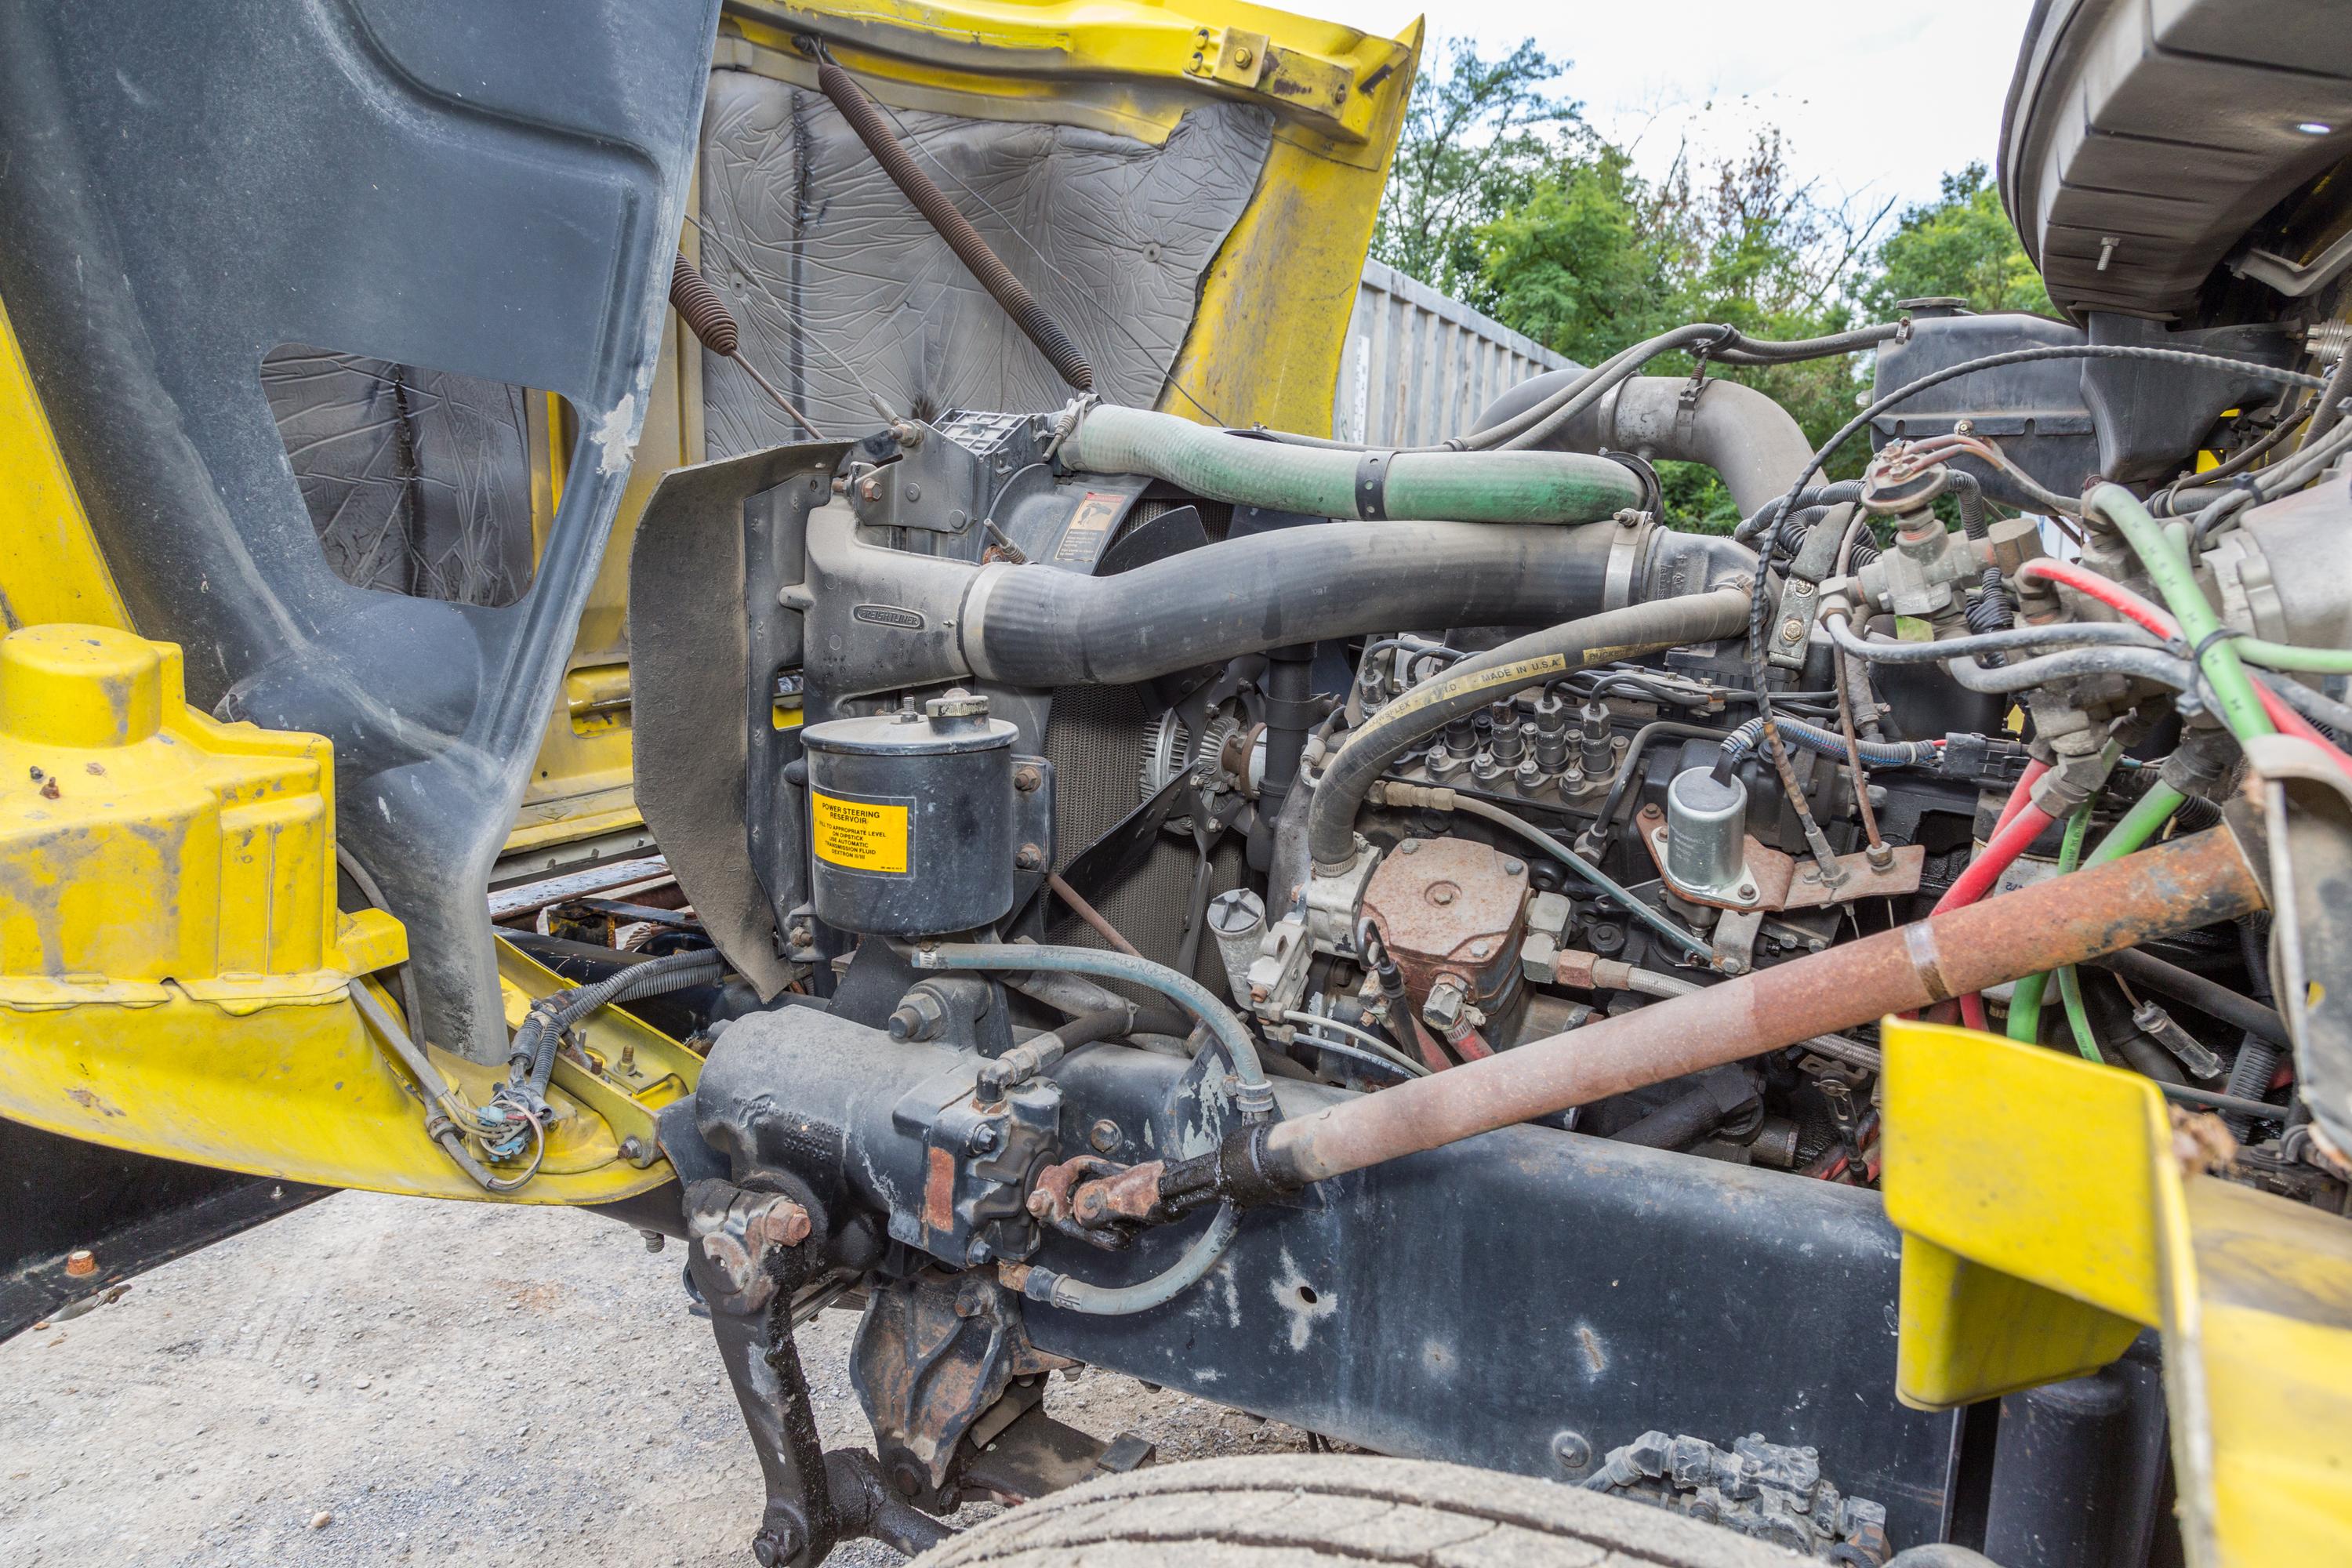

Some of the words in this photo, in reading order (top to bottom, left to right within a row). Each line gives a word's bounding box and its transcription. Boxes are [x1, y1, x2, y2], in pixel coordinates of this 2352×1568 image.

[858, 608, 919, 626] FREIGHTLINER
[1480, 668, 1512, 683] MADE
[1516, 666, 1528, 675] IN
[1532, 659, 1562, 672] U.S.A.
[822, 803, 841, 812] POWER
[844, 808, 880, 818] STEERING
[829, 811, 867, 824] RESERVOIR
[833, 825, 866, 836] APPROPRIATE
[825, 840, 858, 853] TRANSMISSION
[838, 838, 869, 848] AUTOMATIC
[831, 848, 854, 858] DEXTRON
